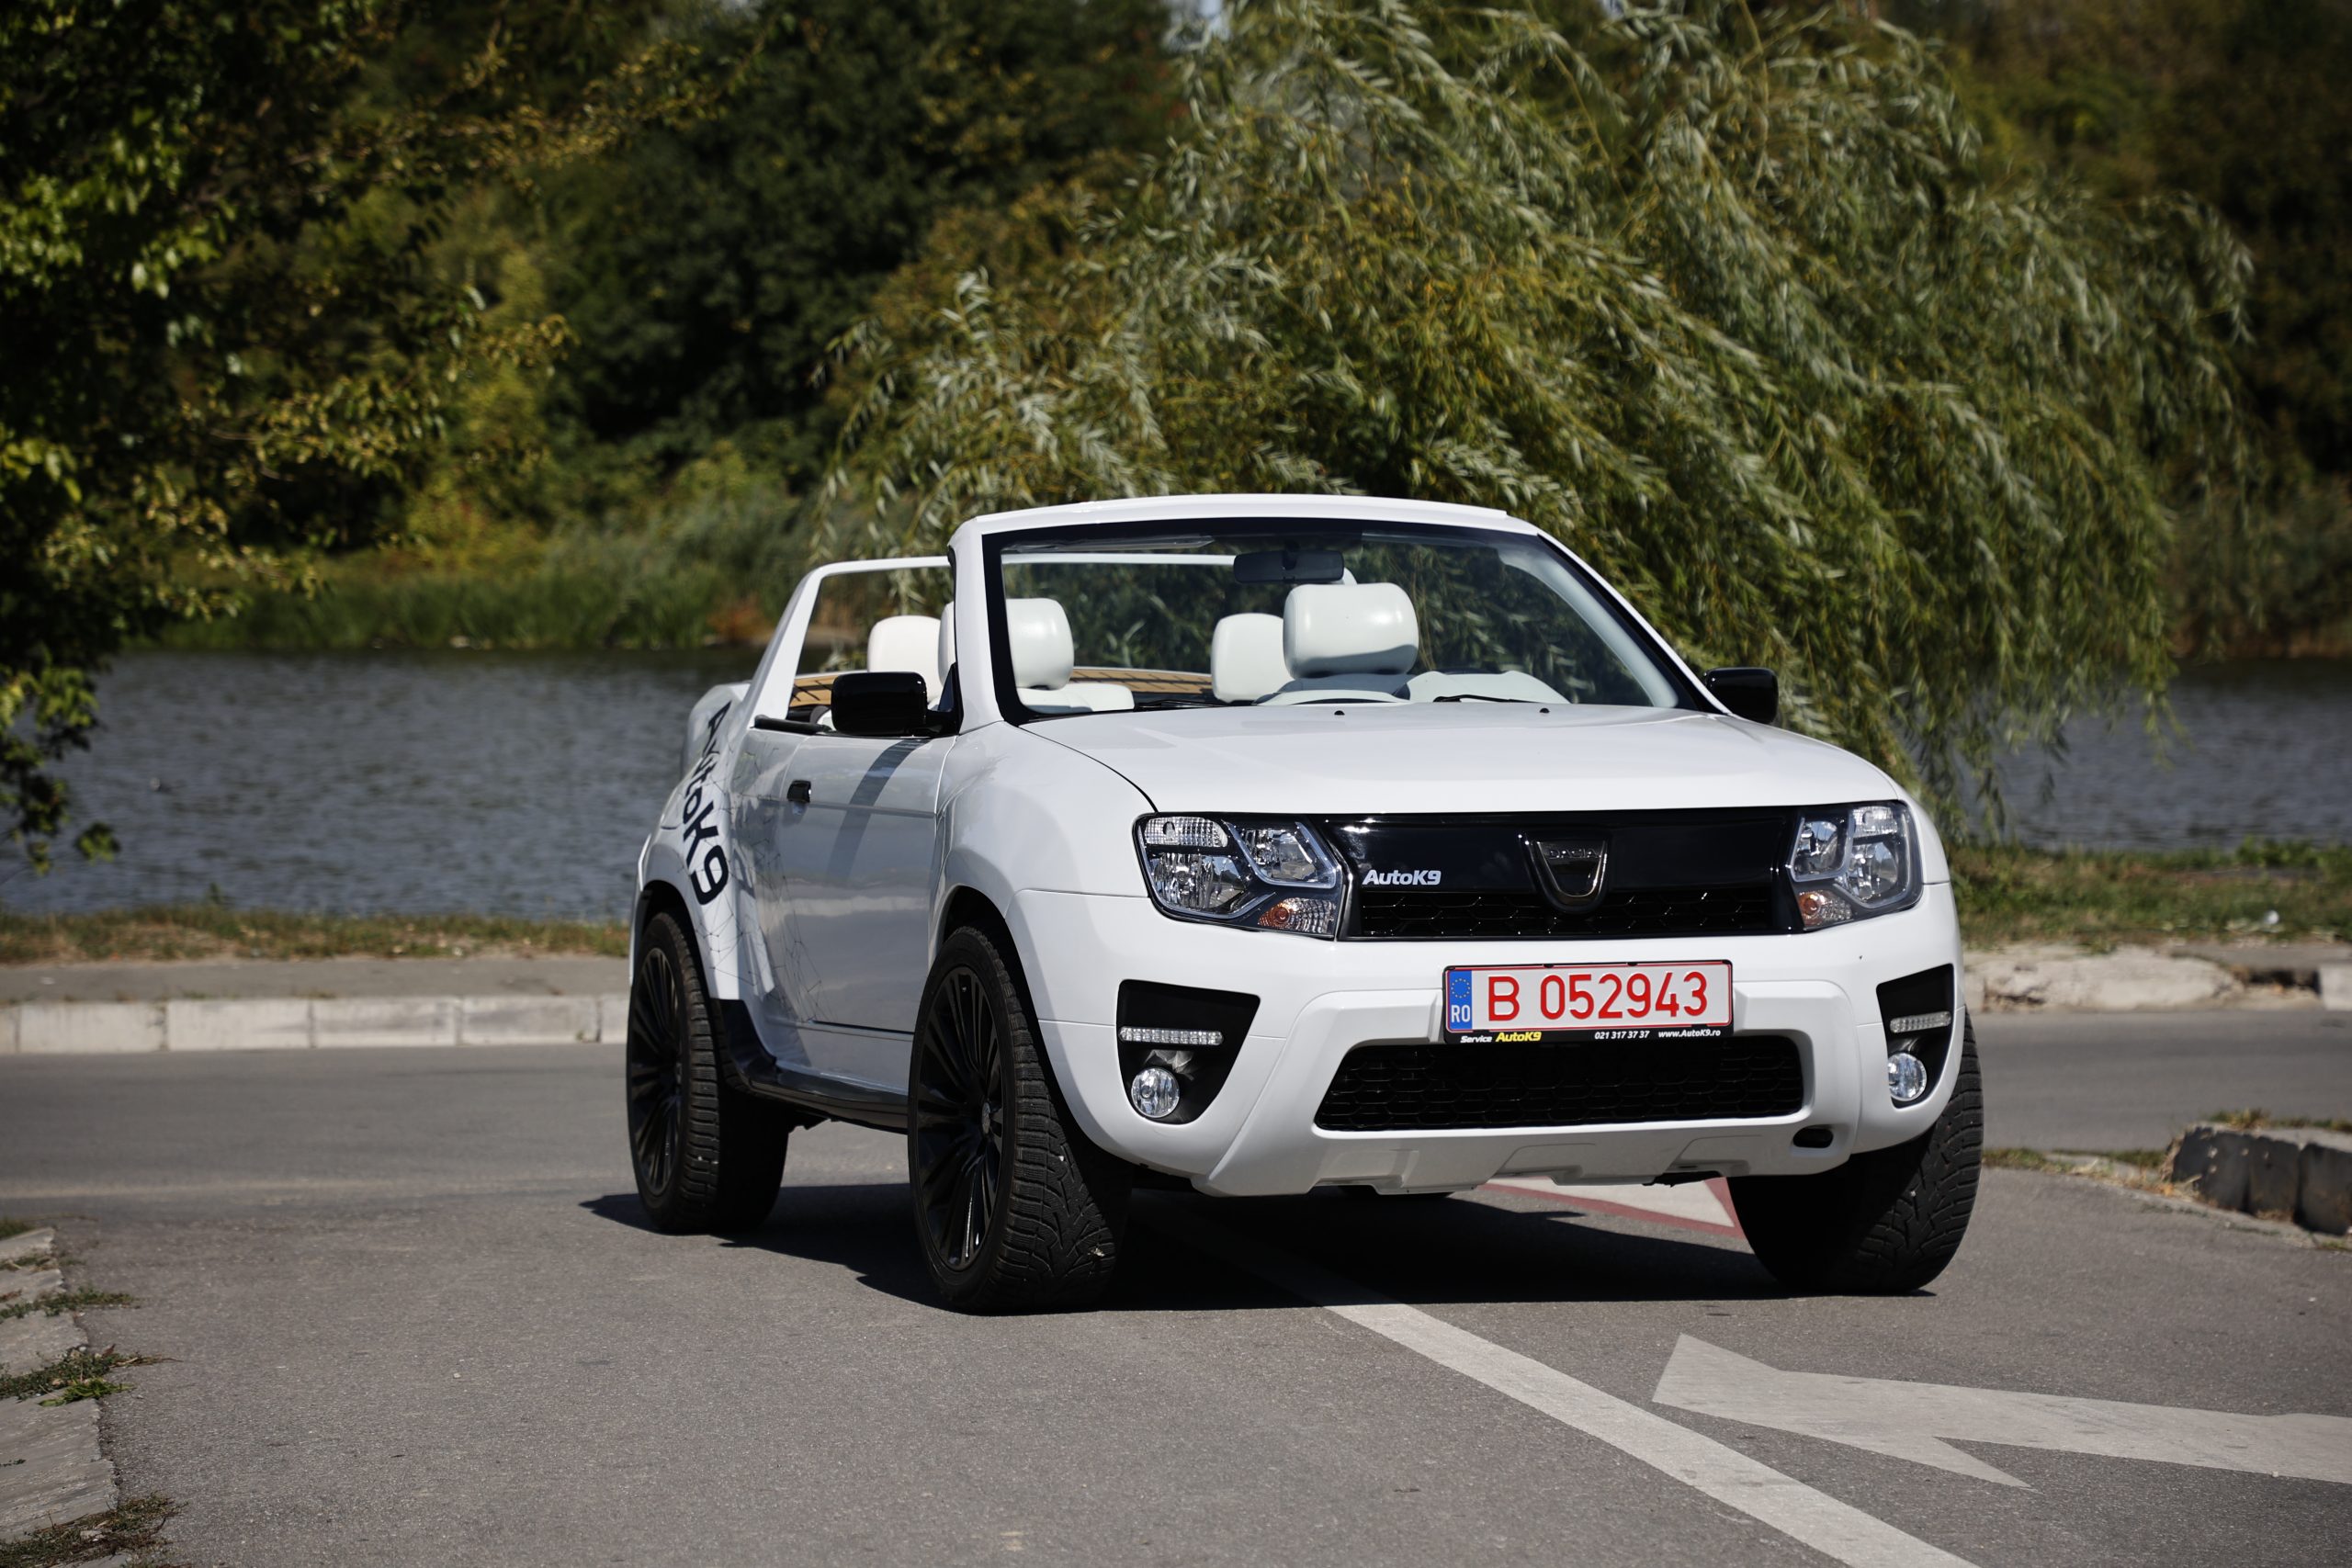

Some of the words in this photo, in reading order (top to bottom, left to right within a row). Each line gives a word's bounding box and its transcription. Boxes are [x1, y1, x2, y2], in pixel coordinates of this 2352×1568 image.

[1362, 869, 1442, 886] AutoK9
[1488, 976, 1521, 1021] B
[1540, 971, 1708, 1021] 052943
[1451, 1004, 1471, 1023] RO
[1460, 1034, 1493, 1043] Service
[1495, 1031, 1543, 1043] AutoK9
[1594, 1031, 1611, 1040] 021
[1611, 1031, 1627, 1040] 317
[1627, 1031, 1639, 1039] 37
[1638, 1030, 1650, 1039] 37
[1657, 1028, 1722, 1038] www.AutoK9.ro
